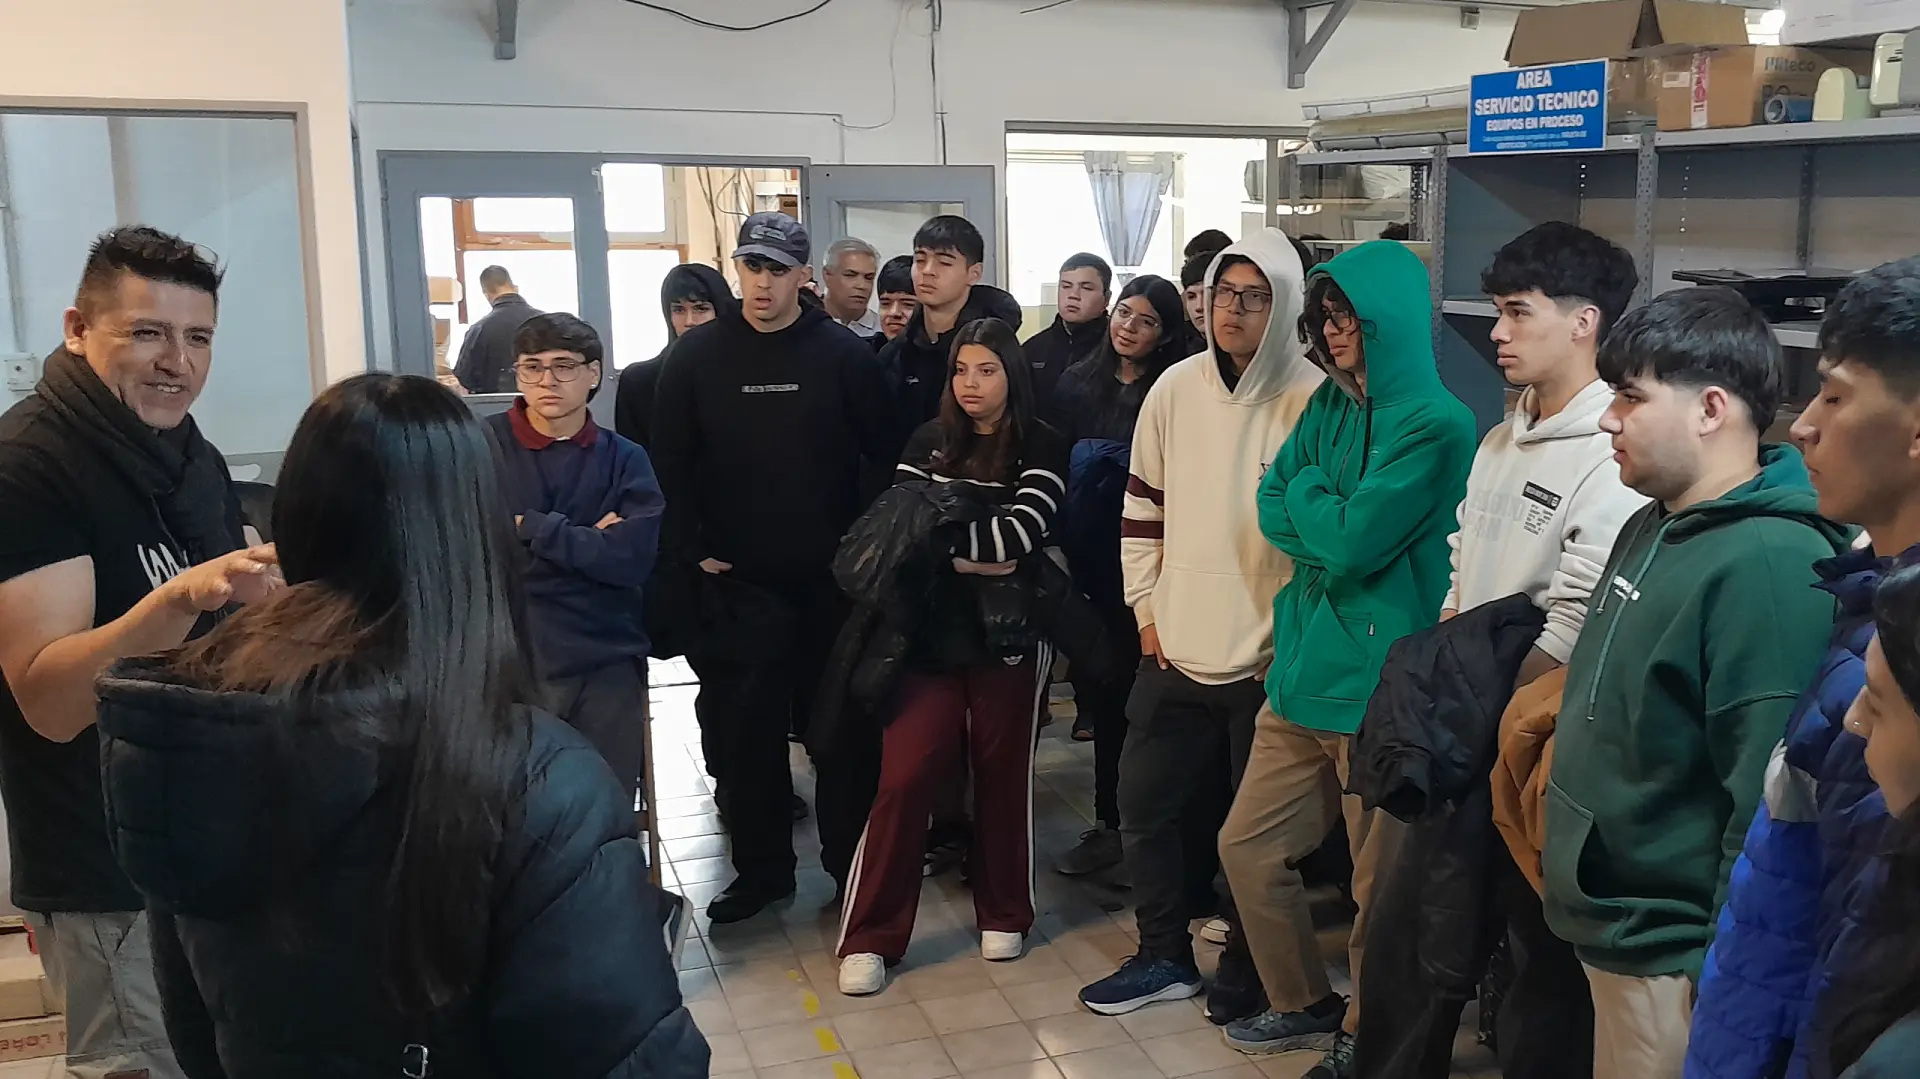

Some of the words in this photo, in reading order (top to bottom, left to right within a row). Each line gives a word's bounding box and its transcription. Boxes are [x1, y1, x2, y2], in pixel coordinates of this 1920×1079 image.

[1516, 70, 1552, 89] AREA
[1474, 95, 1534, 116] SERVICIO
[1536, 89, 1599, 111] TECNICO
[1486, 118, 1524, 131] EQUIPOS
[1525, 116, 1538, 129] EN
[1539, 114, 1584, 128] PROCESO
